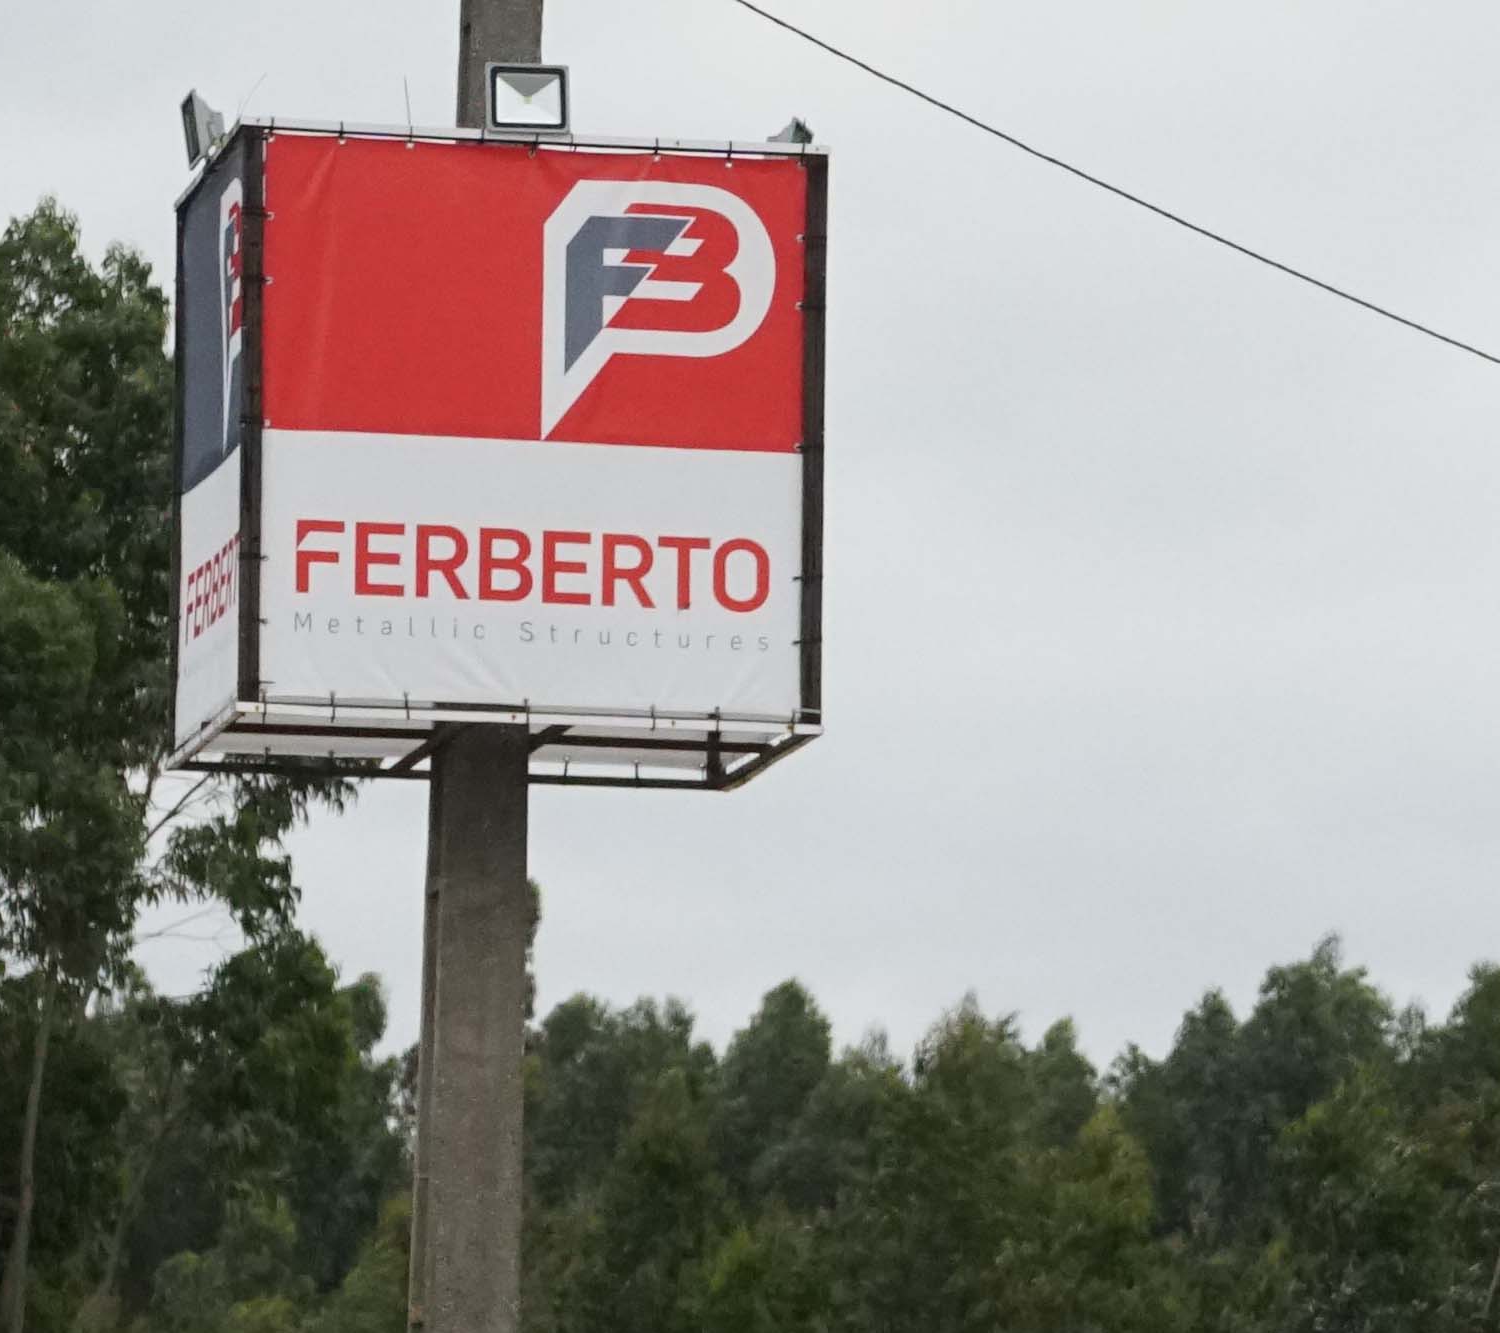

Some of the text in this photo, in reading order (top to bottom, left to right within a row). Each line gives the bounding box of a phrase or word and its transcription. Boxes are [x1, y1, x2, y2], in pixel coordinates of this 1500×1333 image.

[185, 532, 242, 646] FERBERT
[295, 519, 771, 613] FERBERTO
[293, 612, 770, 652] Metallic Structures
